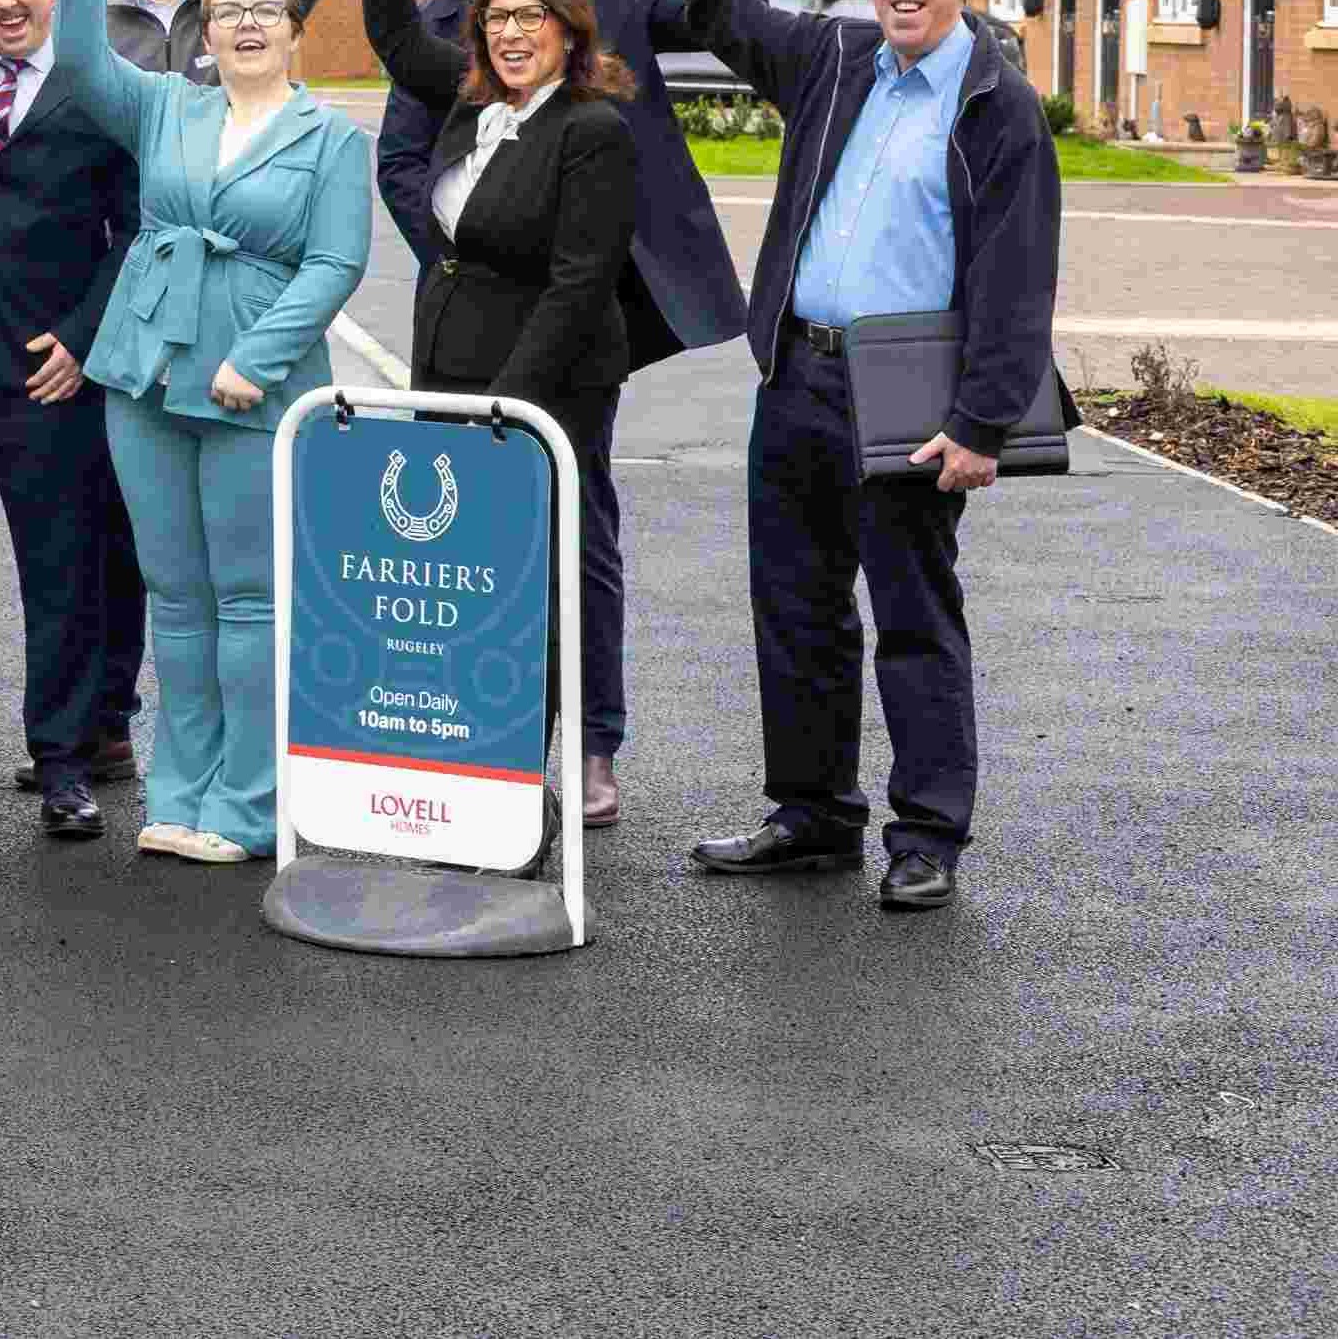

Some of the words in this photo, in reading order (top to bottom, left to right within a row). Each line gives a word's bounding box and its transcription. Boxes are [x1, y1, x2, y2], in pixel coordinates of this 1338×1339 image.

[341, 554, 494, 593] FARRIER'S
[376, 595, 458, 627] FOLD
[386, 638, 444, 655] RUGELEY
[370, 686, 414, 708] Open
[419, 691, 459, 715] Daily
[358, 710, 405, 731] 10am
[409, 716, 427, 733] to
[431, 718, 470, 740] 5pm
[371, 794, 451, 824] LOVELL
[390, 821, 431, 836] HOMES
